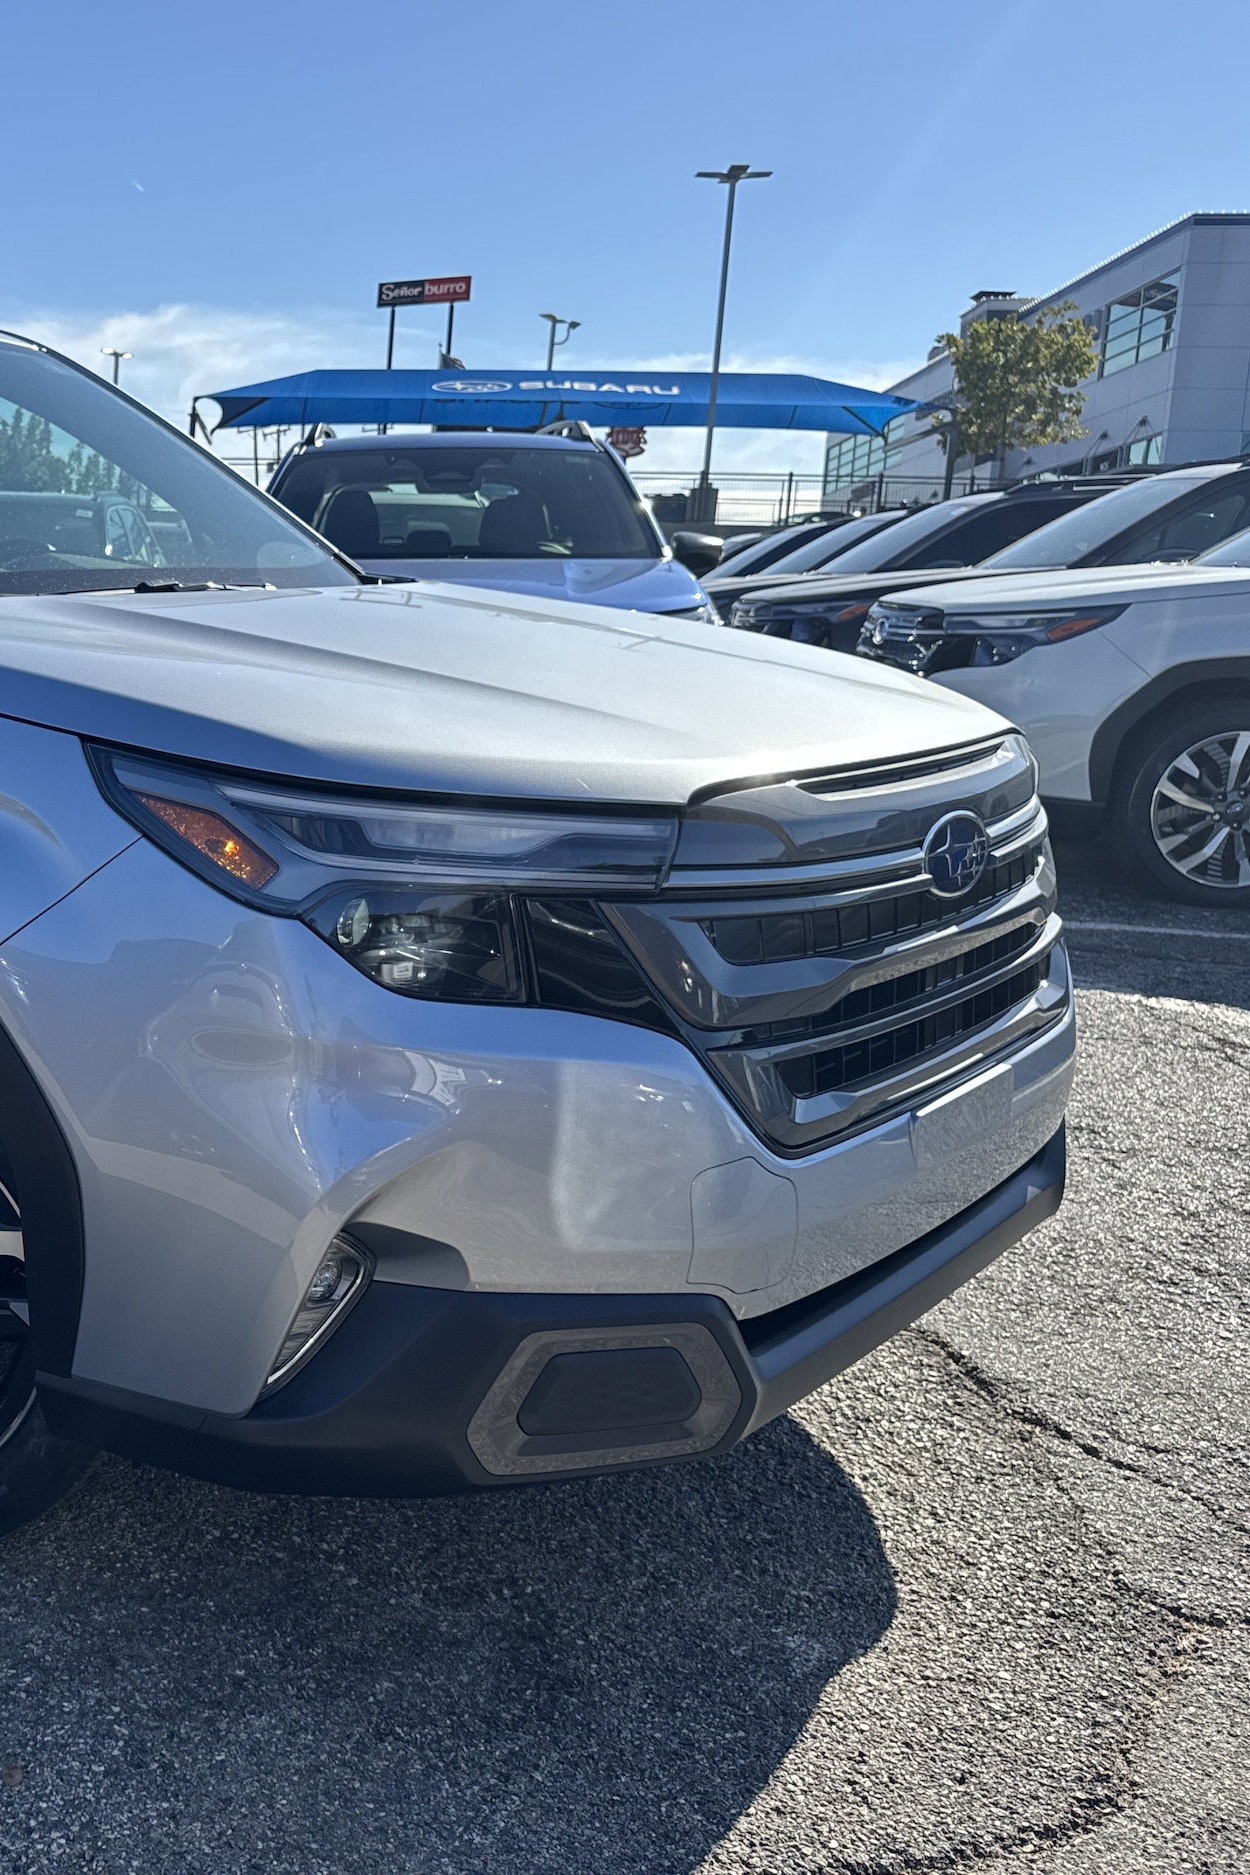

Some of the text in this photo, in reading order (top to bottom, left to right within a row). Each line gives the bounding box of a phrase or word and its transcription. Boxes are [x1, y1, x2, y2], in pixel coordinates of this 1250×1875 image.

[381, 284, 422, 300] Señor
[424, 282, 466, 295] burro
[518, 380, 681, 396] SUBARU
